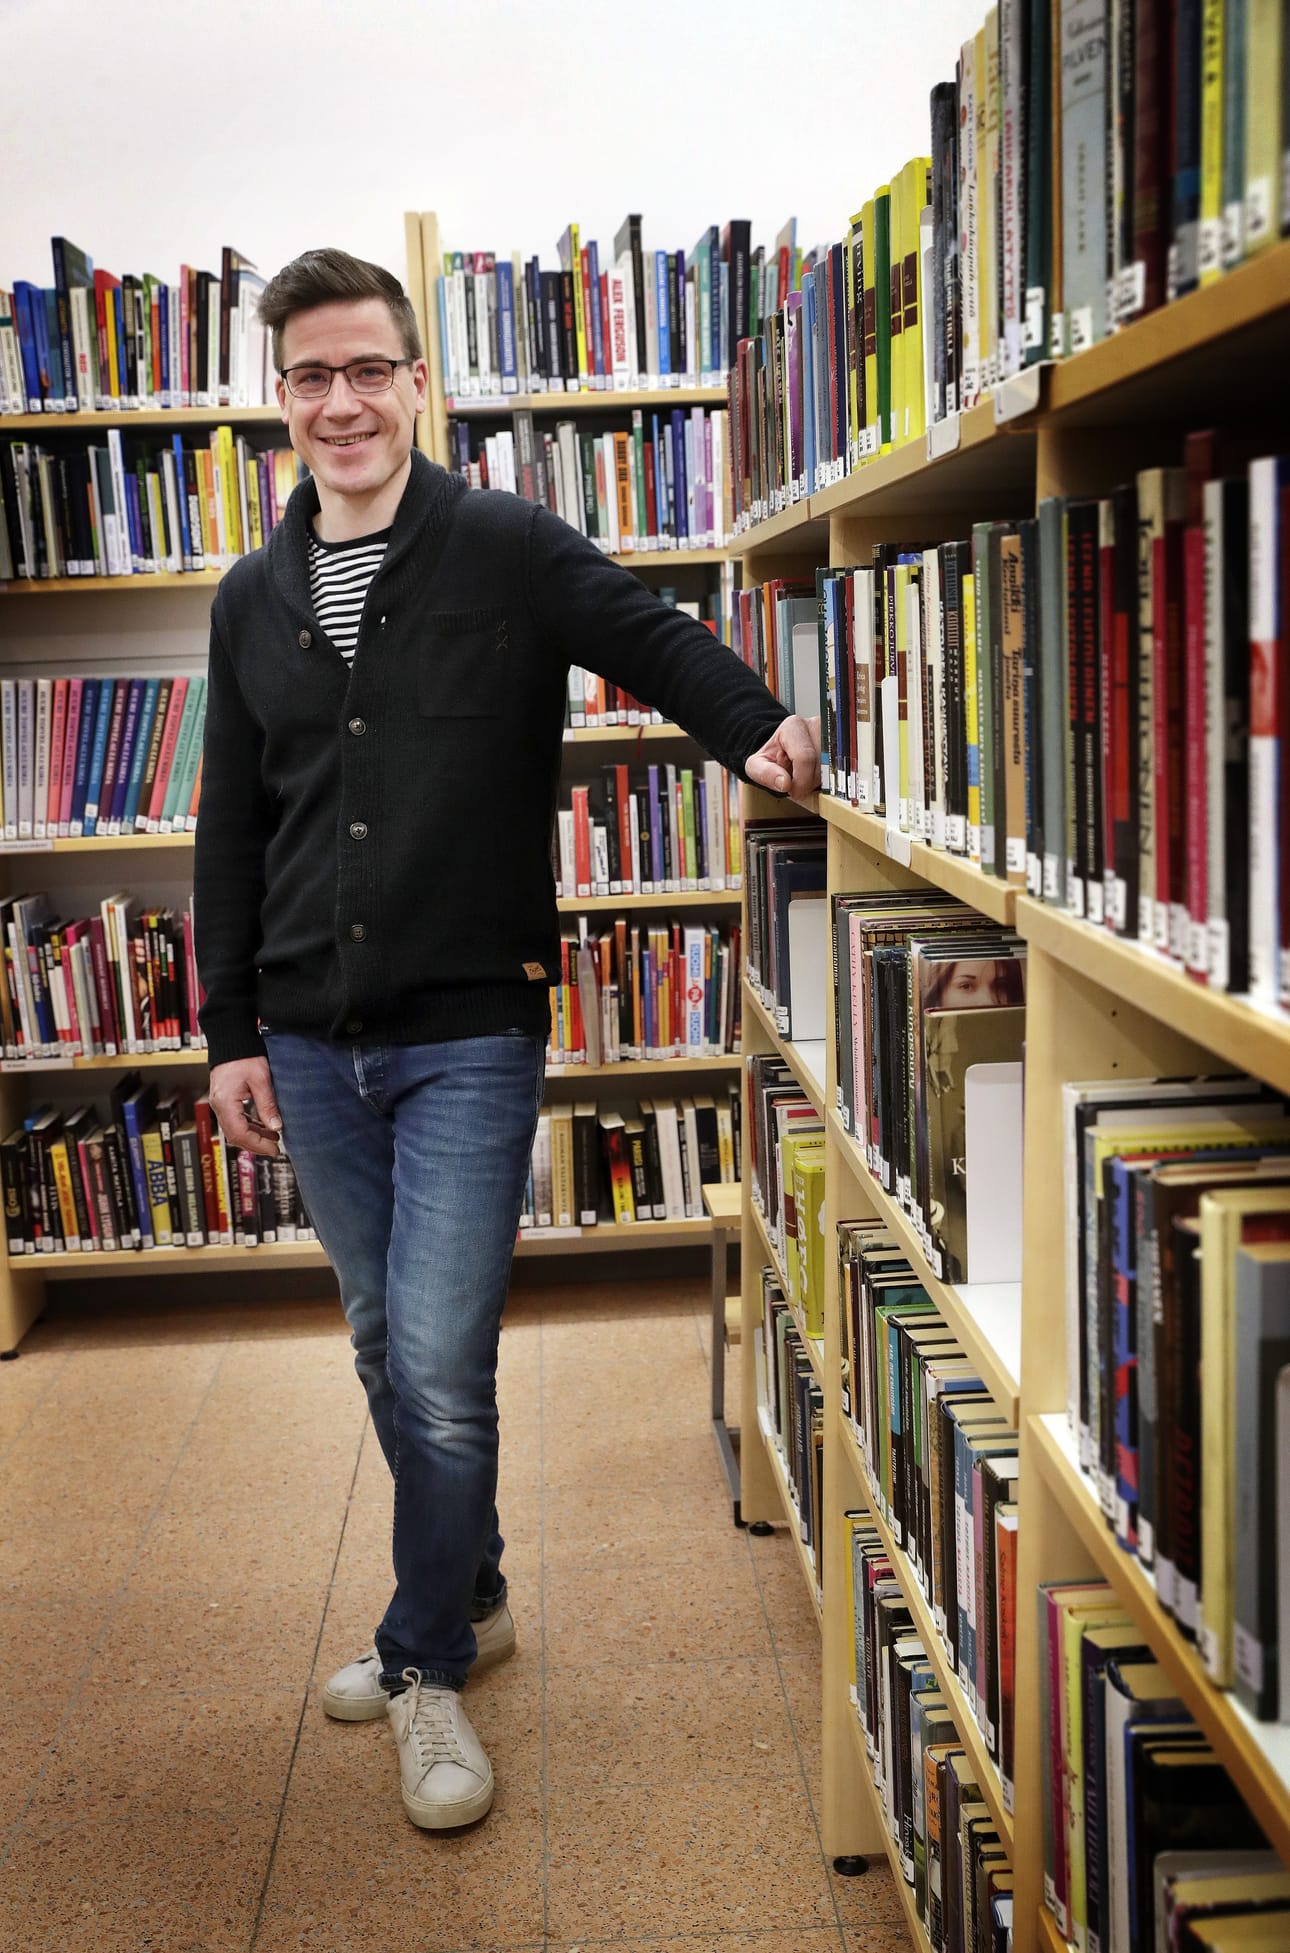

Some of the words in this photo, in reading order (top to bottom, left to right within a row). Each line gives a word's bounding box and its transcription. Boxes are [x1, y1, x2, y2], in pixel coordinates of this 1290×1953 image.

[612, 279, 624, 304] ALEX
[613, 307, 627, 363] FERGUSON
[908, 1005, 916, 1089] Kingsbury
[147, 1160, 168, 1207] ABBA
[201, 1153, 213, 1193] QUEEN
